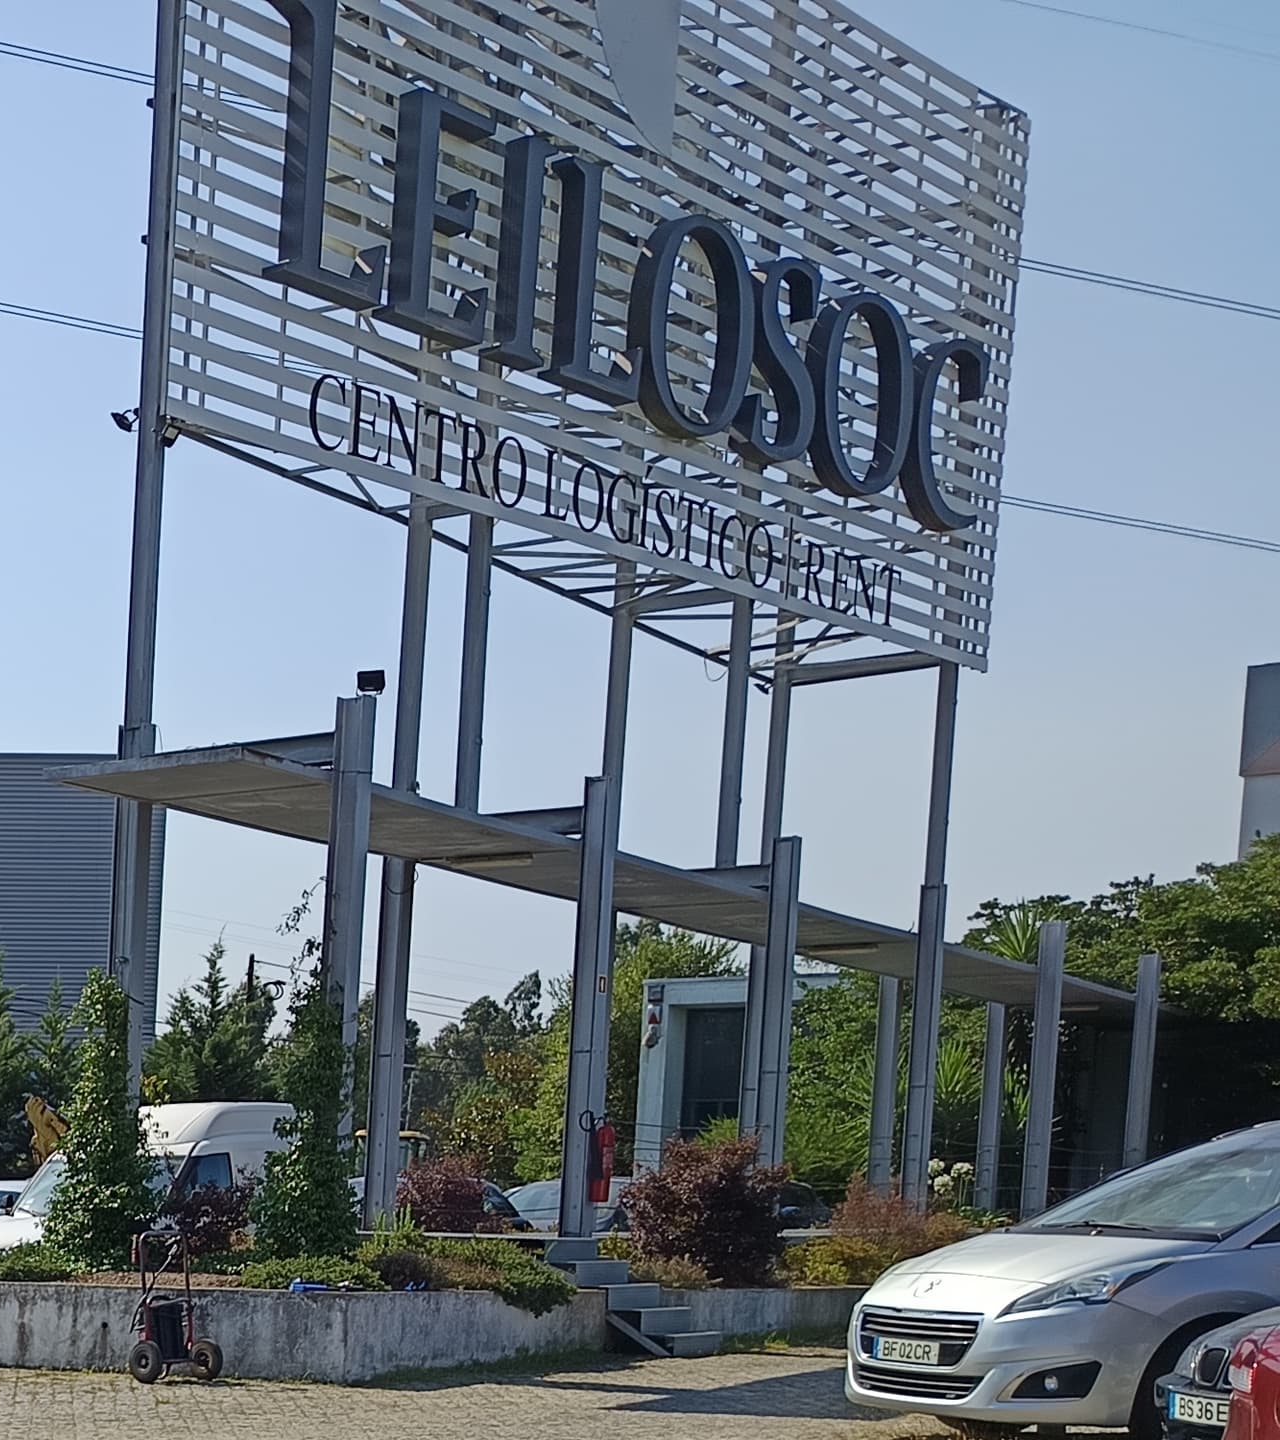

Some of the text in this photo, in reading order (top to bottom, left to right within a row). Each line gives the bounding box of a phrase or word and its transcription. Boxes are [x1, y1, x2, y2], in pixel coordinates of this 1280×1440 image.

[262, 0, 988, 532] LEILOSOC
[308, 374, 902, 627] CENTRO LOGÍSTICO RENT
[1179, 1397, 1229, 1422] BS36E
